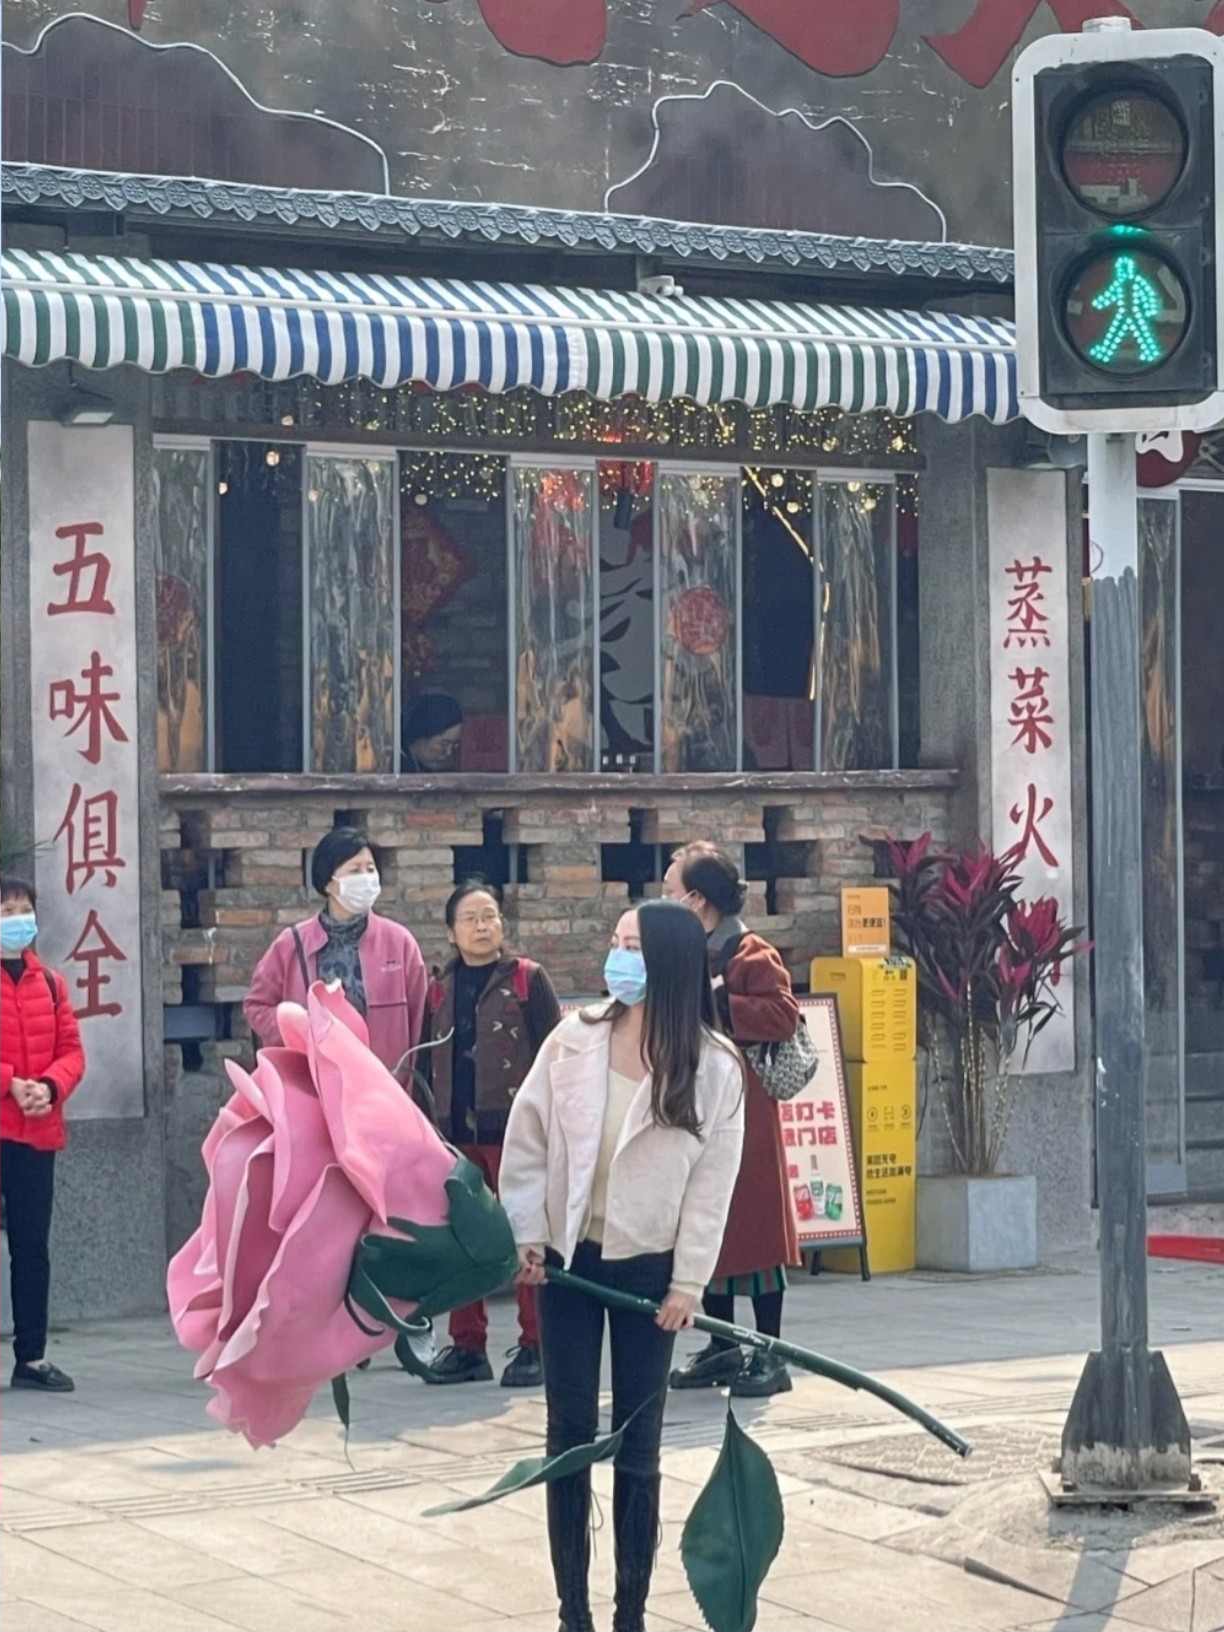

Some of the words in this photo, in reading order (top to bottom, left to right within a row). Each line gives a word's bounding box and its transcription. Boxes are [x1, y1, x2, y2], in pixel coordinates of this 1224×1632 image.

[46, 521, 129, 1019] 五味俱全
[1002, 556, 1060, 987] 蒸菜火
